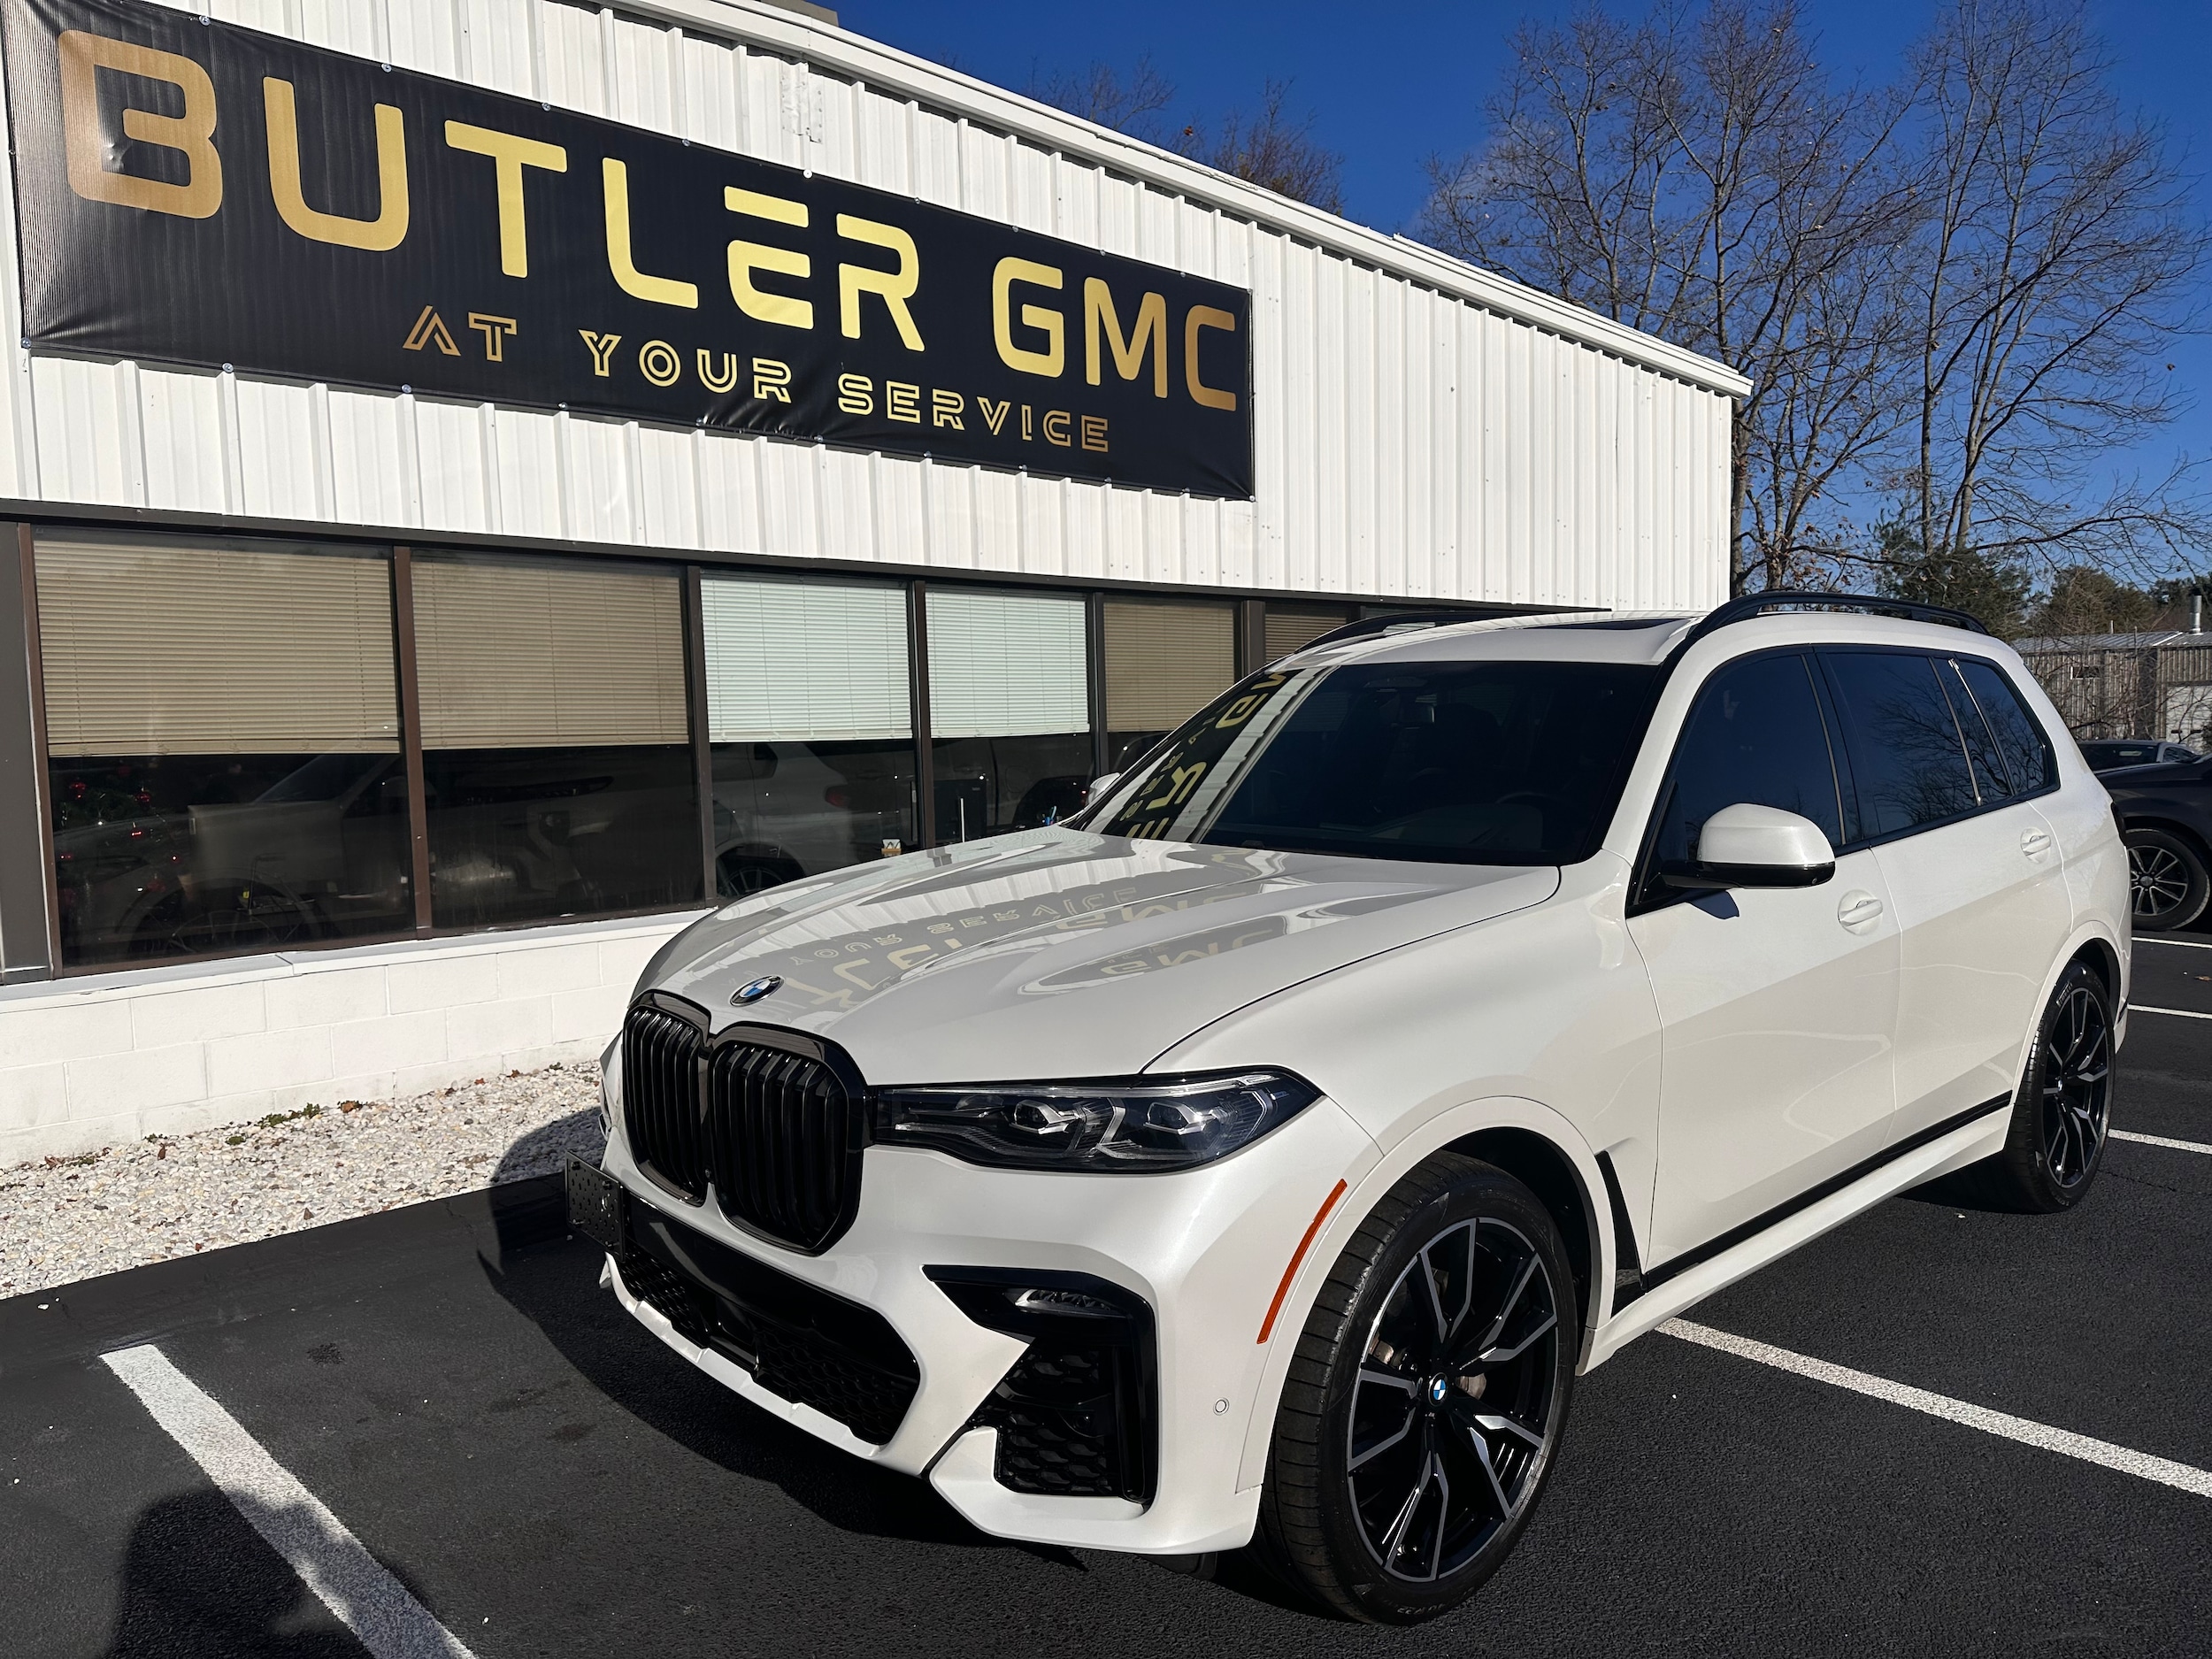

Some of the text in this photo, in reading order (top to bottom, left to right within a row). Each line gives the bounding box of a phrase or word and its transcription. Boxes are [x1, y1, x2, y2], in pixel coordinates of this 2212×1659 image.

[58, 29, 1237, 412] BUTLER GMC
[403, 305, 1110, 453] AT YOUR SERVICE
